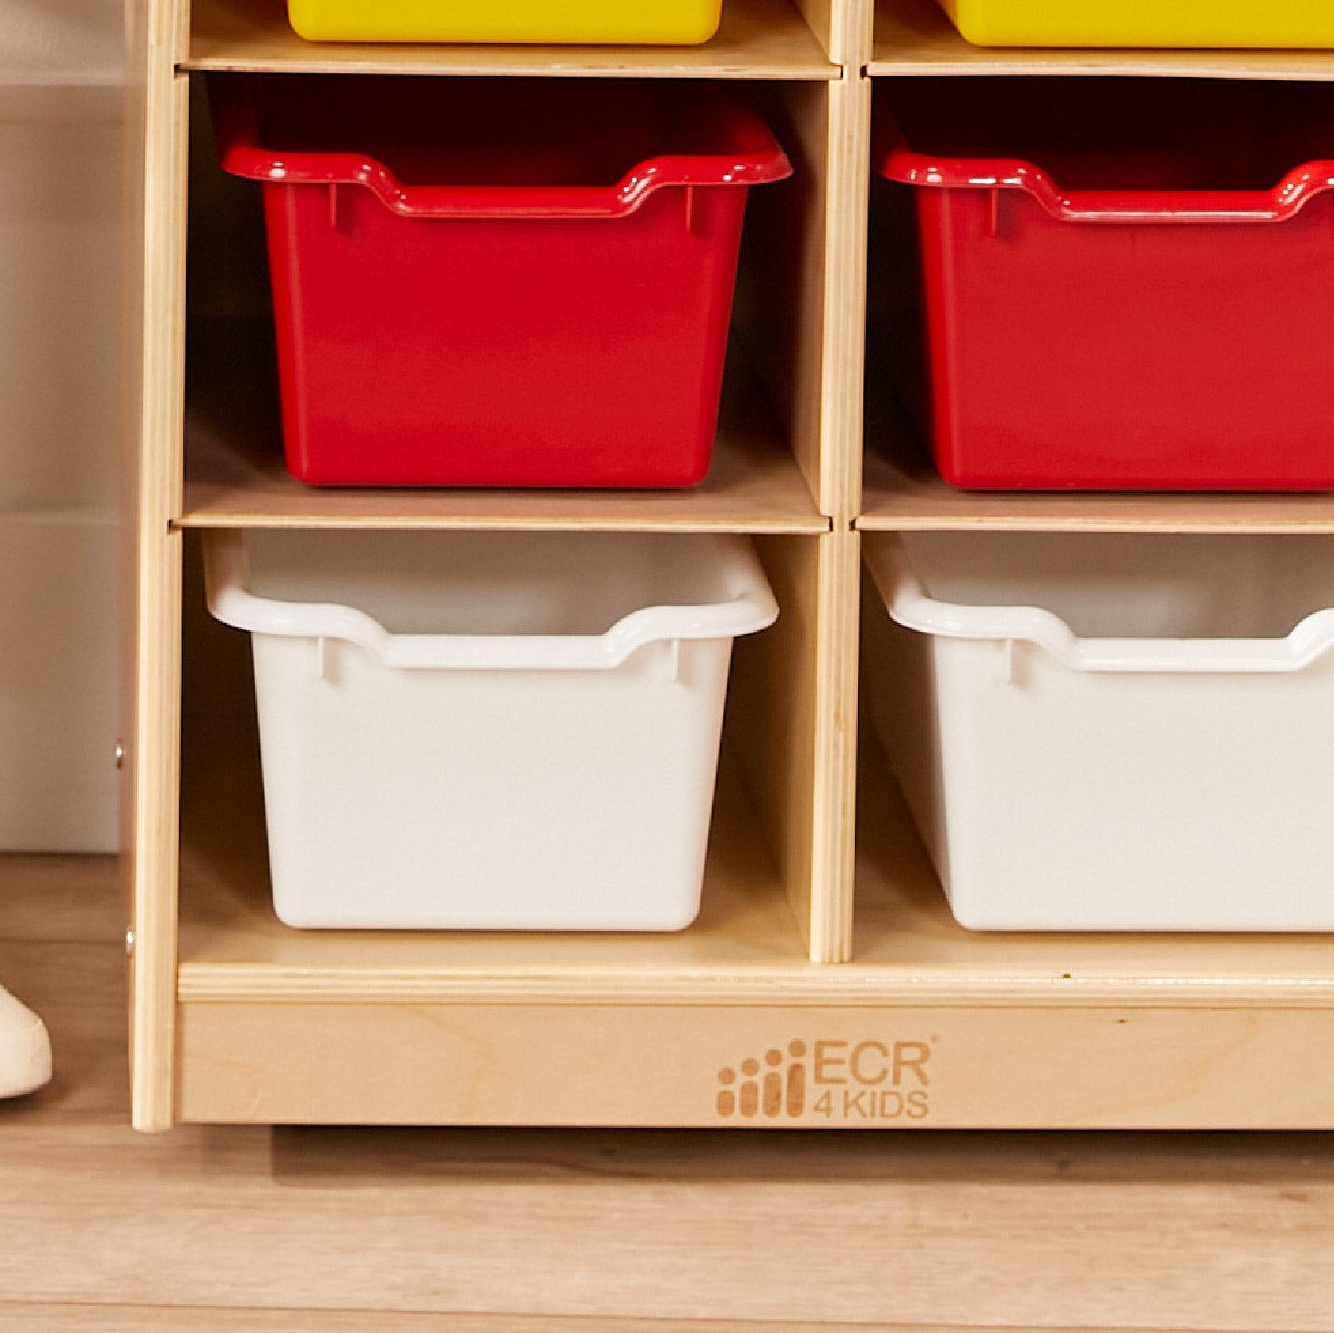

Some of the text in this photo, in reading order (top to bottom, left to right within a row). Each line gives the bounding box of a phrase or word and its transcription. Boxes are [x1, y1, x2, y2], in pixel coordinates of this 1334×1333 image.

[813, 1040, 931, 1086] ECR
[813, 1089, 930, 1119] 4 KIDS
